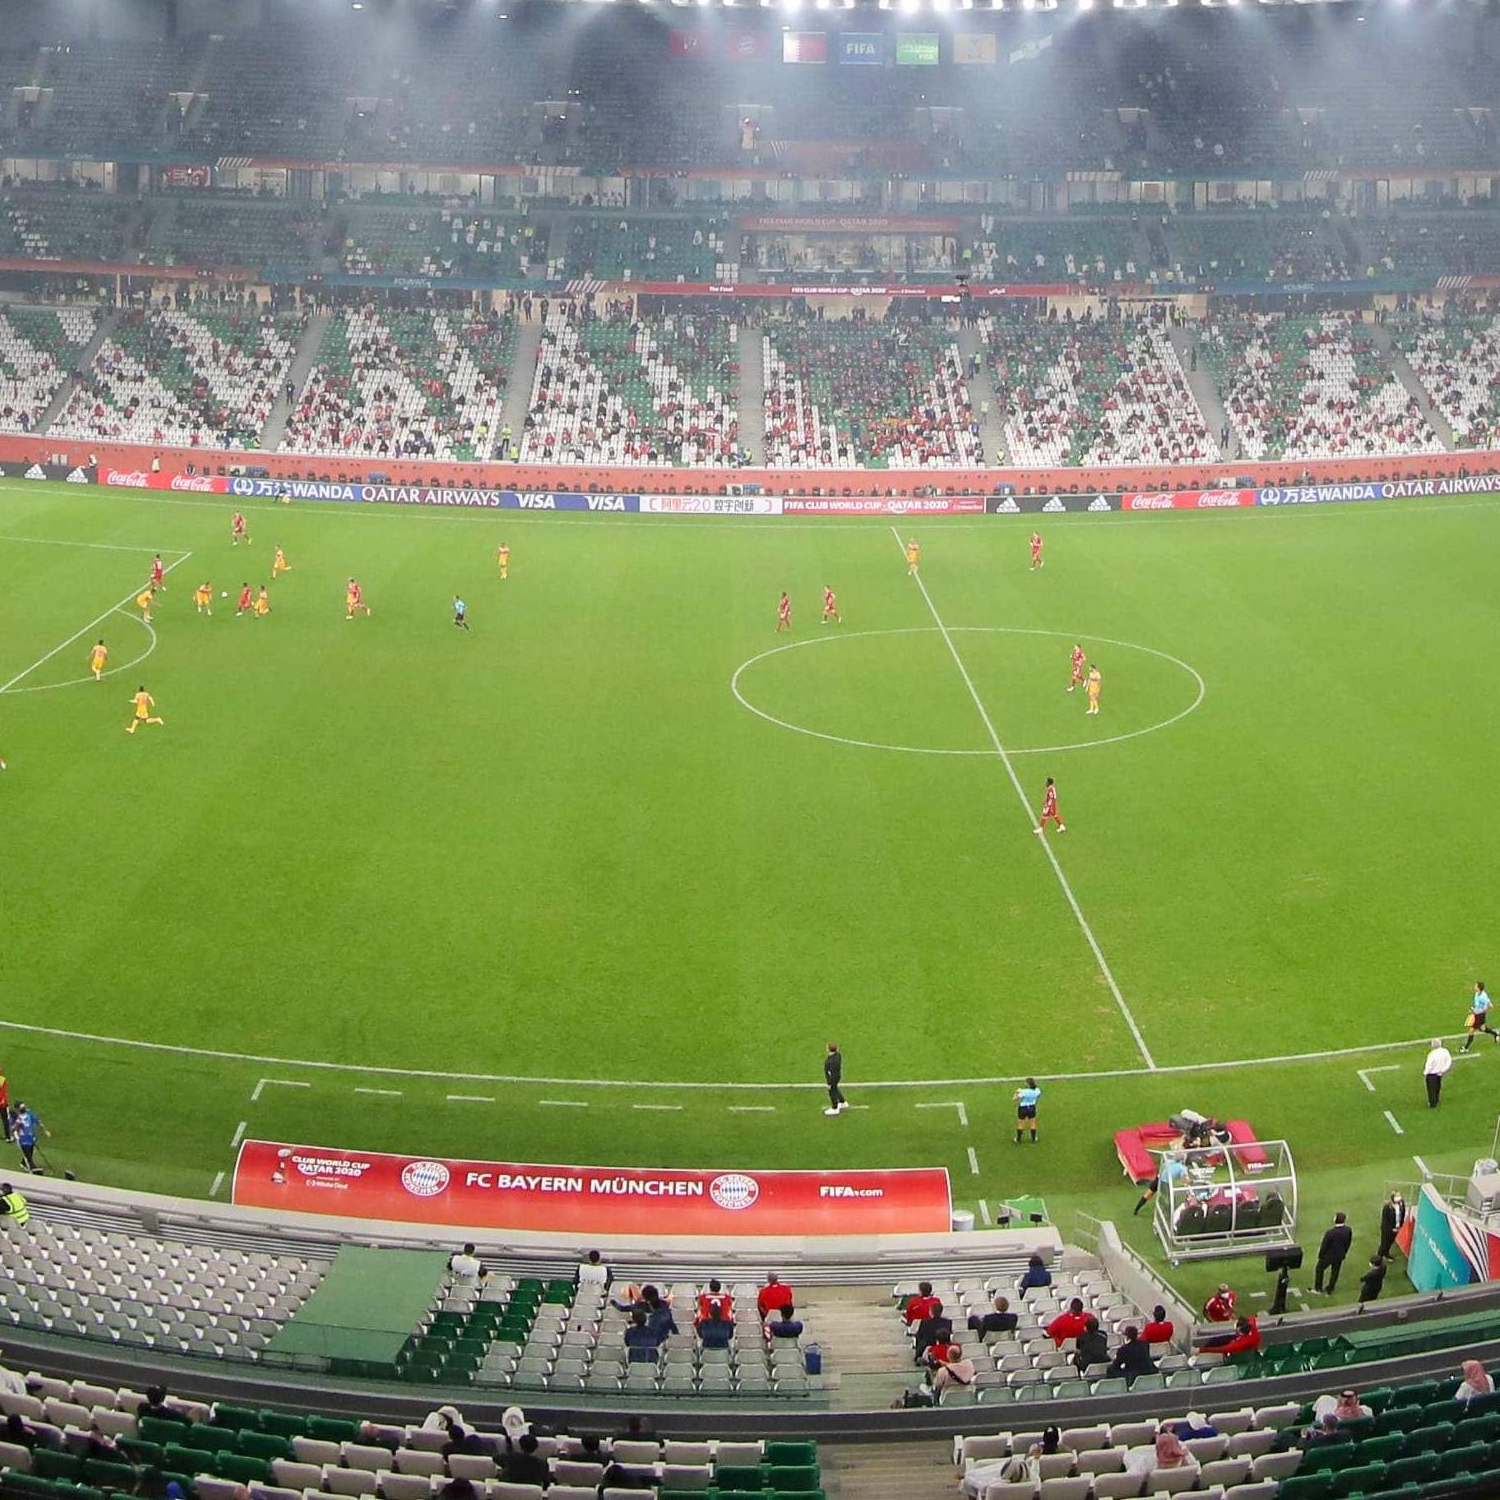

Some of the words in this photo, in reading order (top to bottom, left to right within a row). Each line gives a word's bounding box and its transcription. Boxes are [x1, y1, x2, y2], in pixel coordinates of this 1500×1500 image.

[846, 43, 875, 55] FIFA
[291, 483, 354, 500] WANDA
[361, 486, 422, 503] QATAR
[424, 489, 500, 507] AIRWAYS
[1316, 484, 1375, 501] WANDA
[1381, 480, 1435, 499] QATAR
[515, 493, 556, 509] VISA
[584, 495, 626, 511] VISA
[784, 501, 805, 510] FIFA
[805, 501, 829, 510] CLUB
[829, 501, 863, 510] WORLD
[864, 501, 882, 510] CUP
[887, 501, 921, 513] QATAR
[923, 501, 949, 510] 2020
[292, 1155, 316, 1164] CLUB
[316, 1158, 351, 1168] WORLD
[351, 1162, 371, 1170] CUP
[297, 1163, 334, 1176] QATAR
[335, 1167, 362, 1177] 2020
[465, 1172, 493, 1189] FC
[498, 1174, 583, 1193] BAYERN
[590, 1177, 704, 1196] MÜNCHEN
